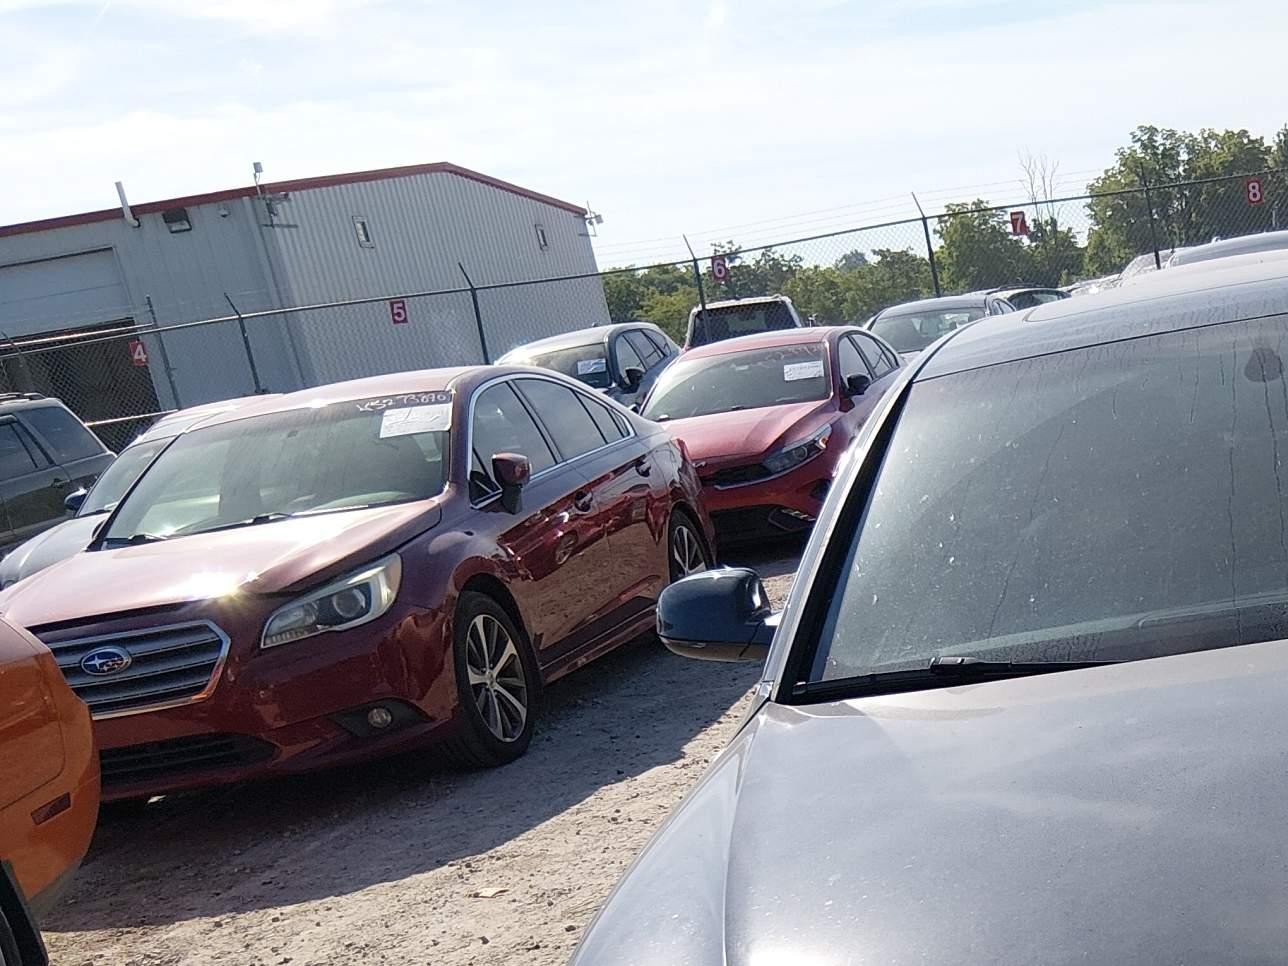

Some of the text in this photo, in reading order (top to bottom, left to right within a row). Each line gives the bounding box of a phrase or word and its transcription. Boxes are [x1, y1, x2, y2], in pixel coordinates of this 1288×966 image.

[1248, 182, 1261, 201] 8
[1011, 213, 1023, 233] 7
[713, 260, 725, 277] 6
[393, 302, 406, 321] 5
[134, 343, 147, 362] 4
